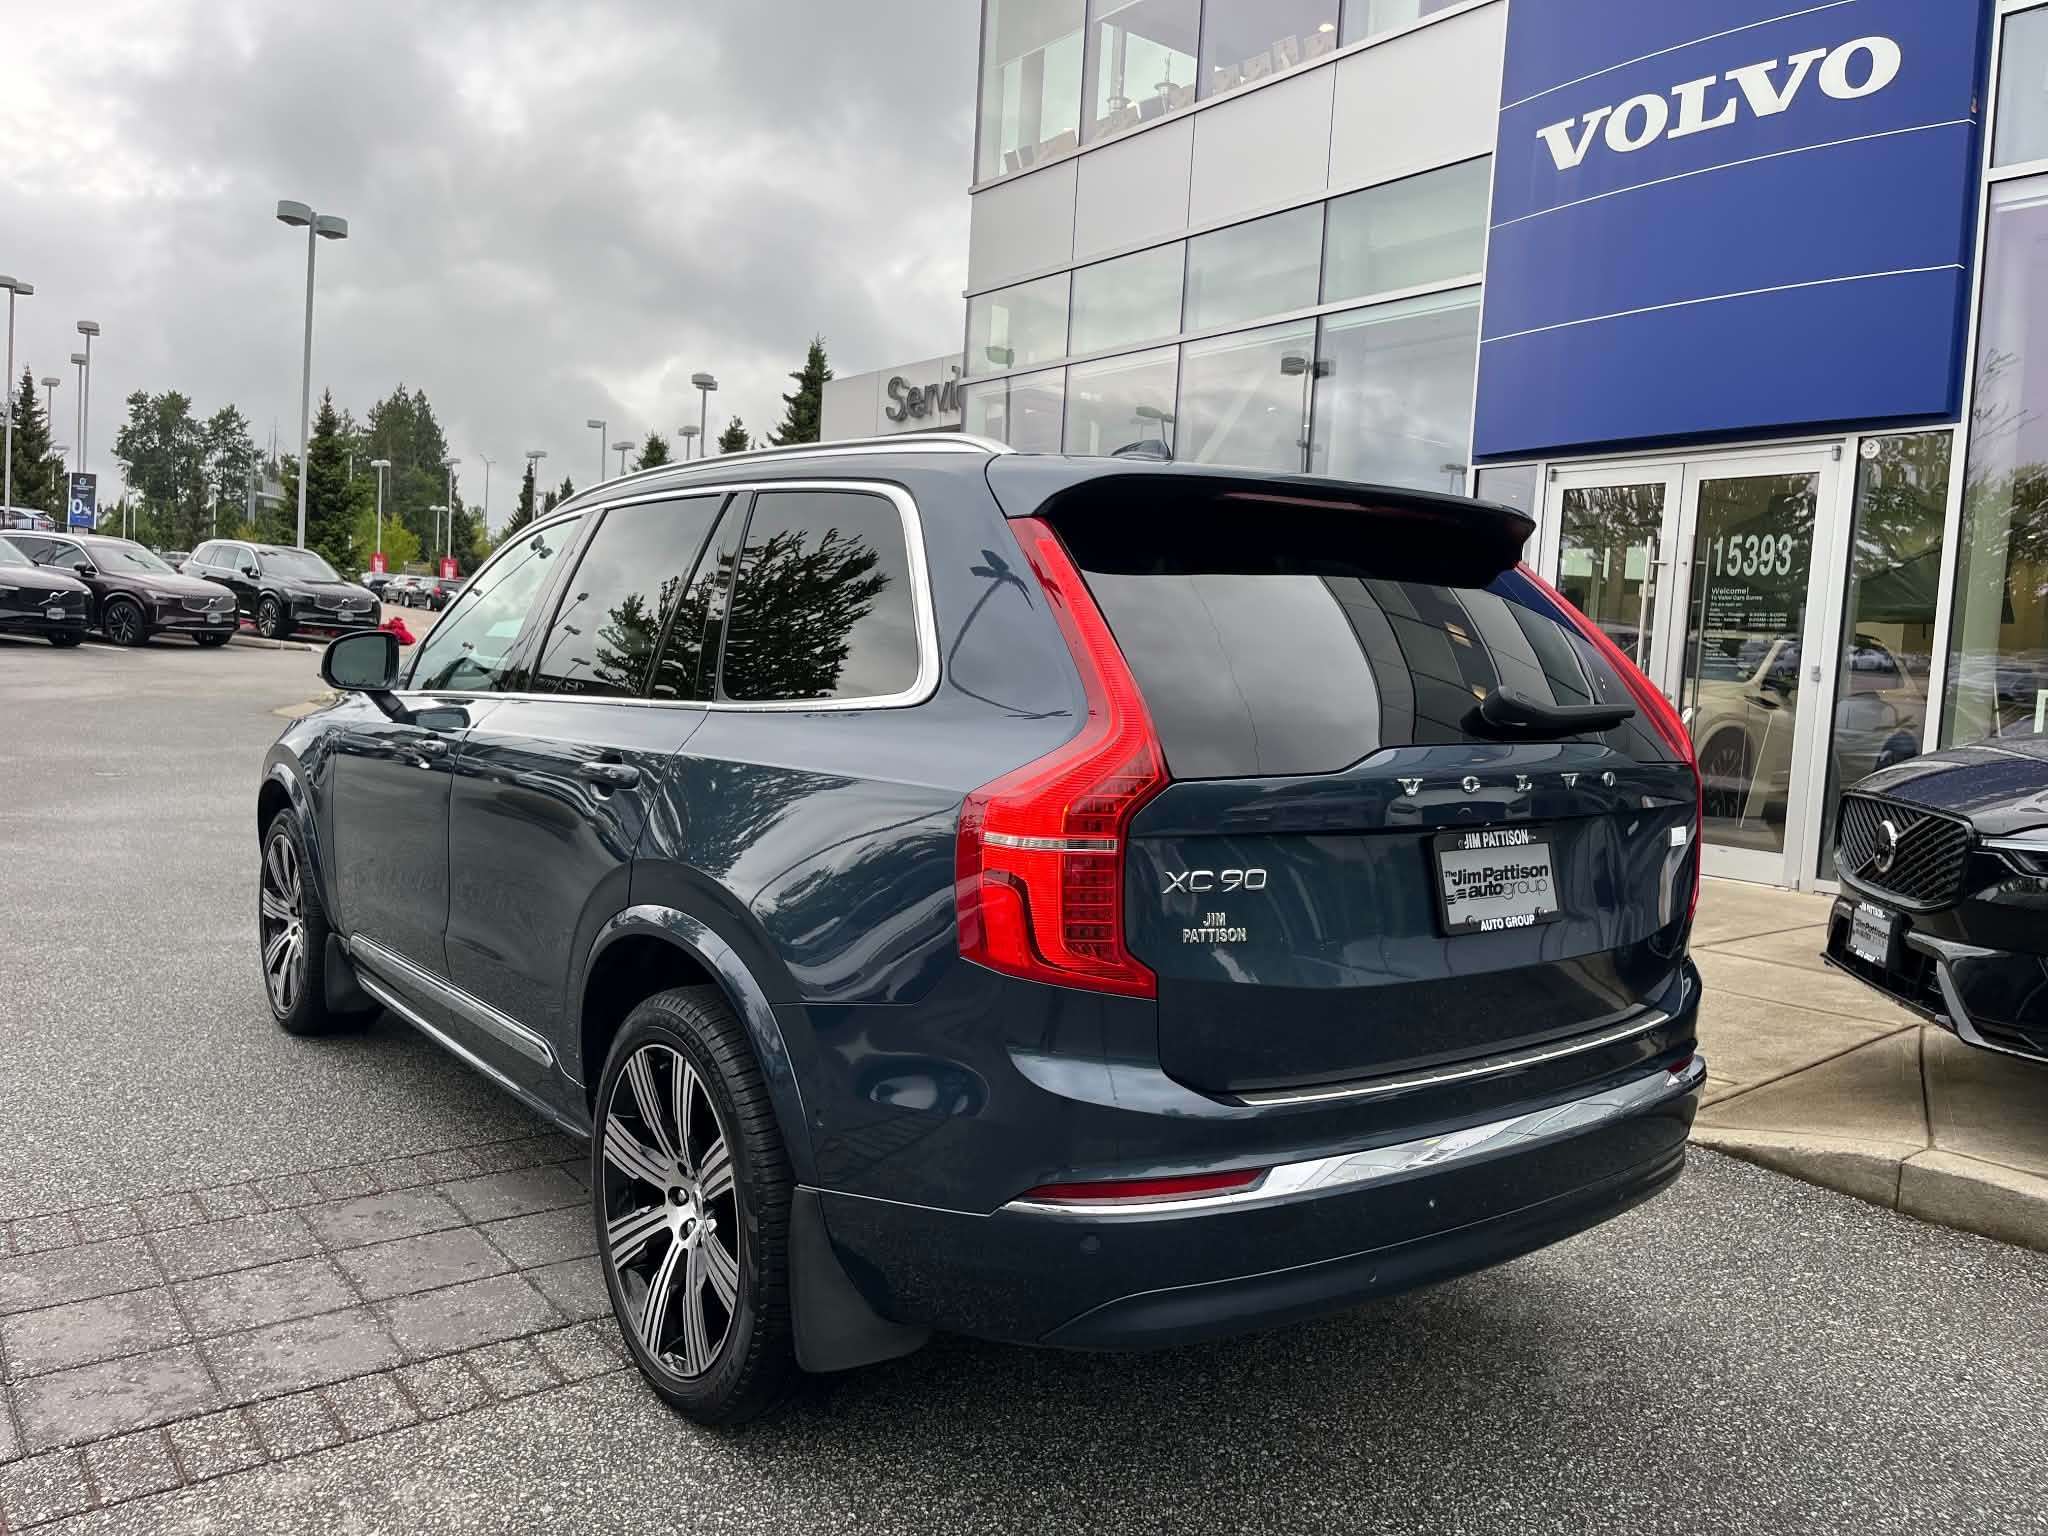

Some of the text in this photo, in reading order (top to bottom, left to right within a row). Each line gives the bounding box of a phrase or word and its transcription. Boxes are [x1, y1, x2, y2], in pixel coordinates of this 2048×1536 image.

[1536, 36, 1901, 171] VOLVO
[885, 365, 961, 422] Servi
[1713, 533, 1793, 577] 15393
[1711, 586, 1750, 595] Welcome!
[1397, 771, 1616, 797] VOLVO
[1464, 829, 1529, 849] JIM PATTISON
[1202, 912, 1226, 927] JIM
[1480, 914, 1535, 931] AUTO GROUP
[1183, 927, 1247, 943] PATTISON
